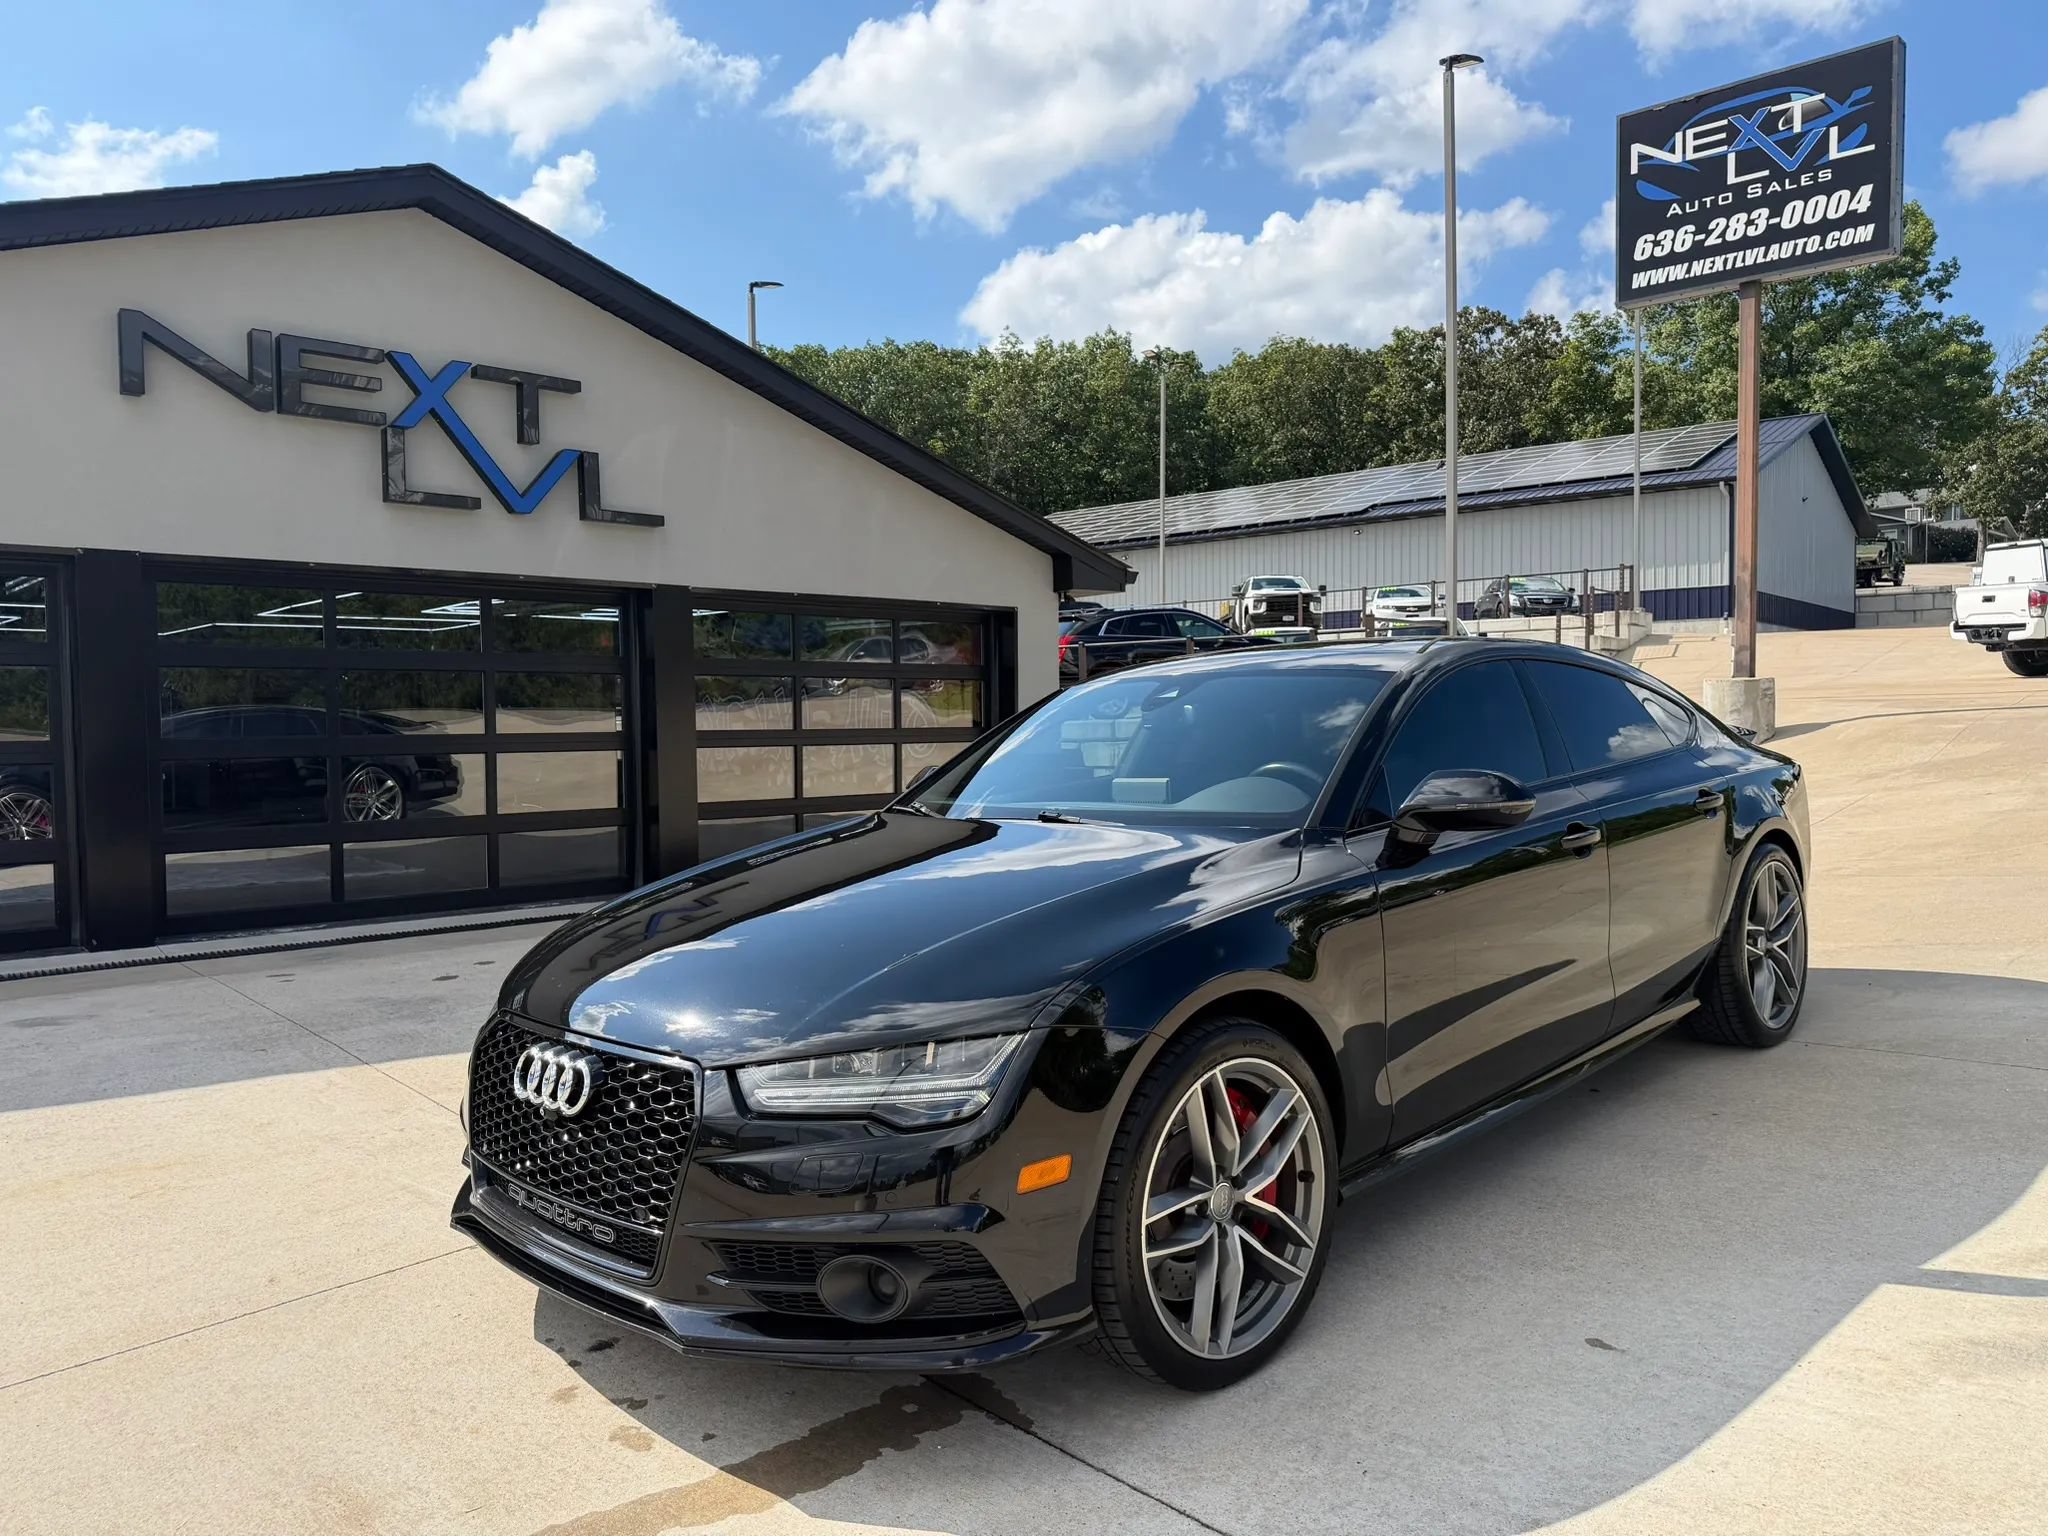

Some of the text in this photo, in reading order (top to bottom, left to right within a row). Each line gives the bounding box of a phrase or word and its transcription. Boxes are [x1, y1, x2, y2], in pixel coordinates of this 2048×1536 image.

[1630, 92, 1826, 175] NEXT
[1726, 125, 1876, 184] LVL
[1633, 183, 1874, 262] 636-283-0004
[1666, 168, 1832, 218] AUTO SALES
[1631, 223, 1876, 289] WWW.NEXTLVLAUTO.COM
[117, 308, 582, 445] NEXT
[381, 427, 666, 527] LVL
[507, 1182, 615, 1243] quattro
